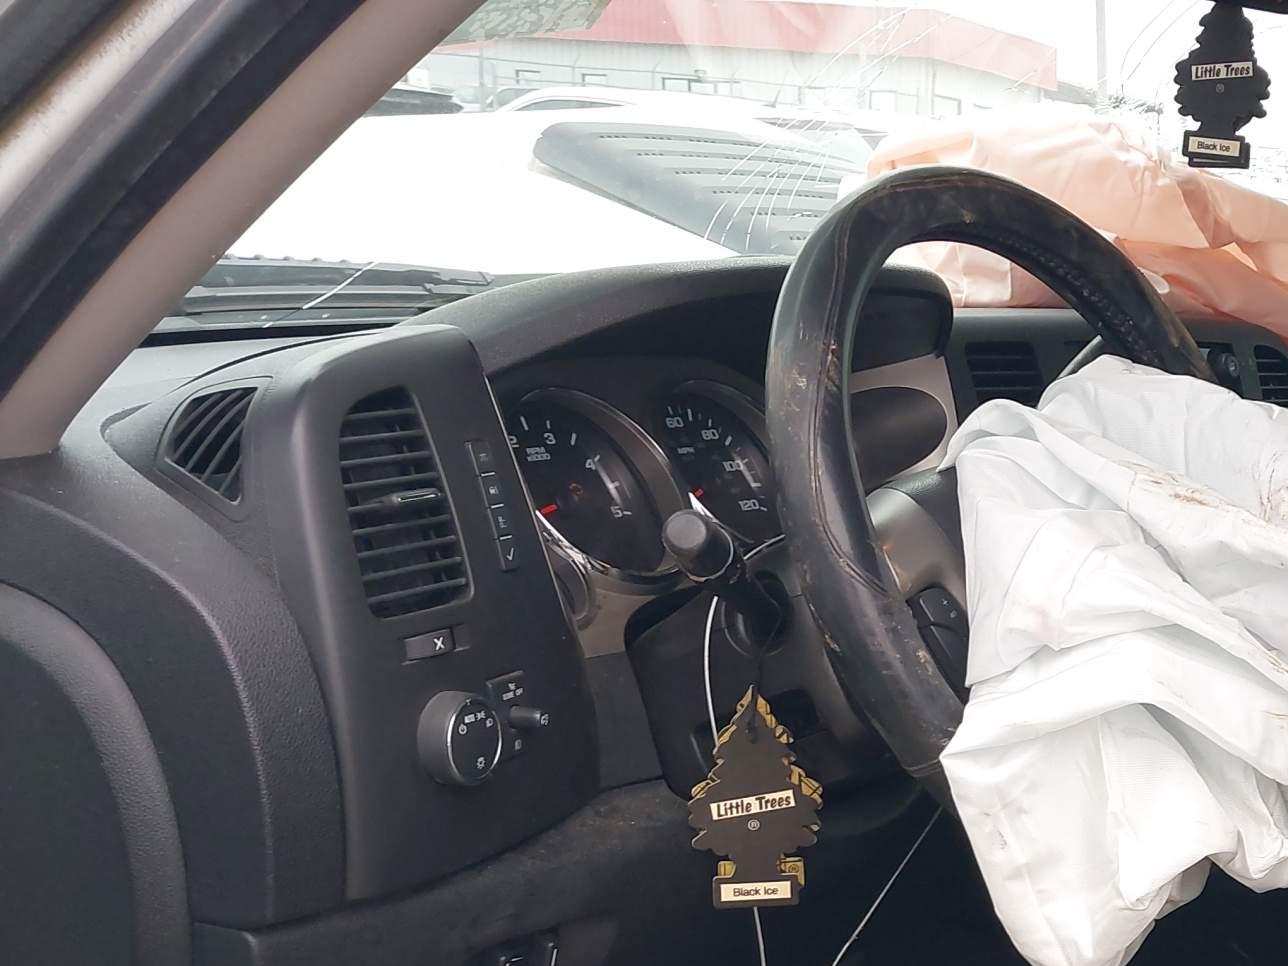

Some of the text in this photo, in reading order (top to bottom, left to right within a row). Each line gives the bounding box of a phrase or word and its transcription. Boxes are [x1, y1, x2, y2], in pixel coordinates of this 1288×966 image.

[1195, 64, 1250, 79] Little Trees
[1197, 141, 1217, 151] Black
[666, 417, 684, 428] 60
[543, 432, 556, 445] 3
[585, 459, 596, 470] 4
[723, 460, 743, 471] 100
[739, 499, 759, 511] 120
[611, 506, 623, 518] 5
[716, 795, 791, 818] Little Trees
[733, 886, 779, 897] Black Ice
